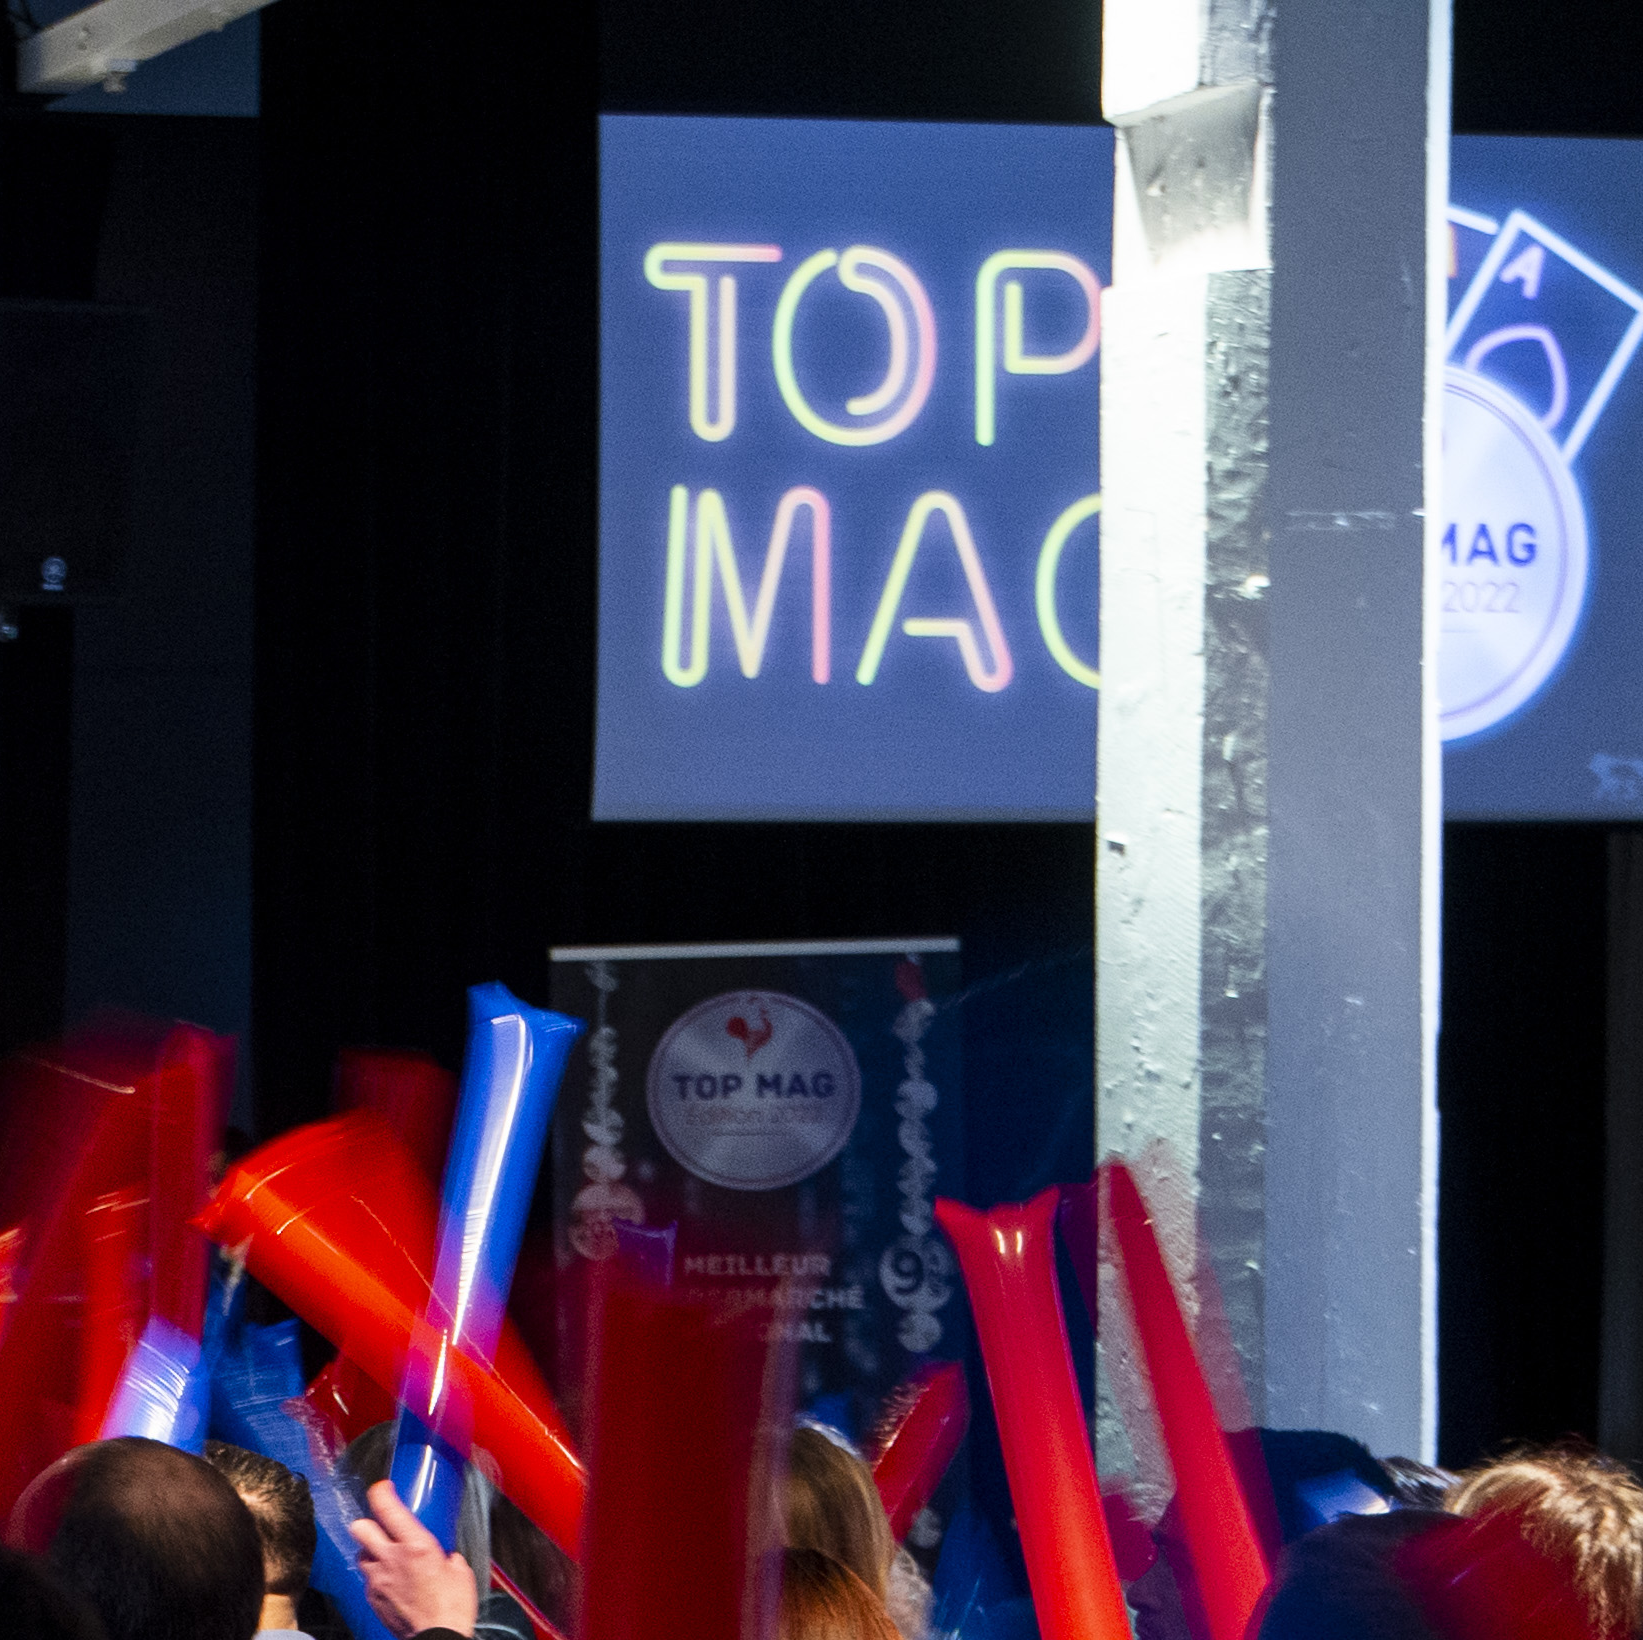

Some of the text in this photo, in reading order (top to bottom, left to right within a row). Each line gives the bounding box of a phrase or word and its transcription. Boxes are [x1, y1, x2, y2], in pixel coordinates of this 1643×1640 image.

[644, 243, 1103, 447] TOP
[672, 1071, 836, 1100] TOP MAG
